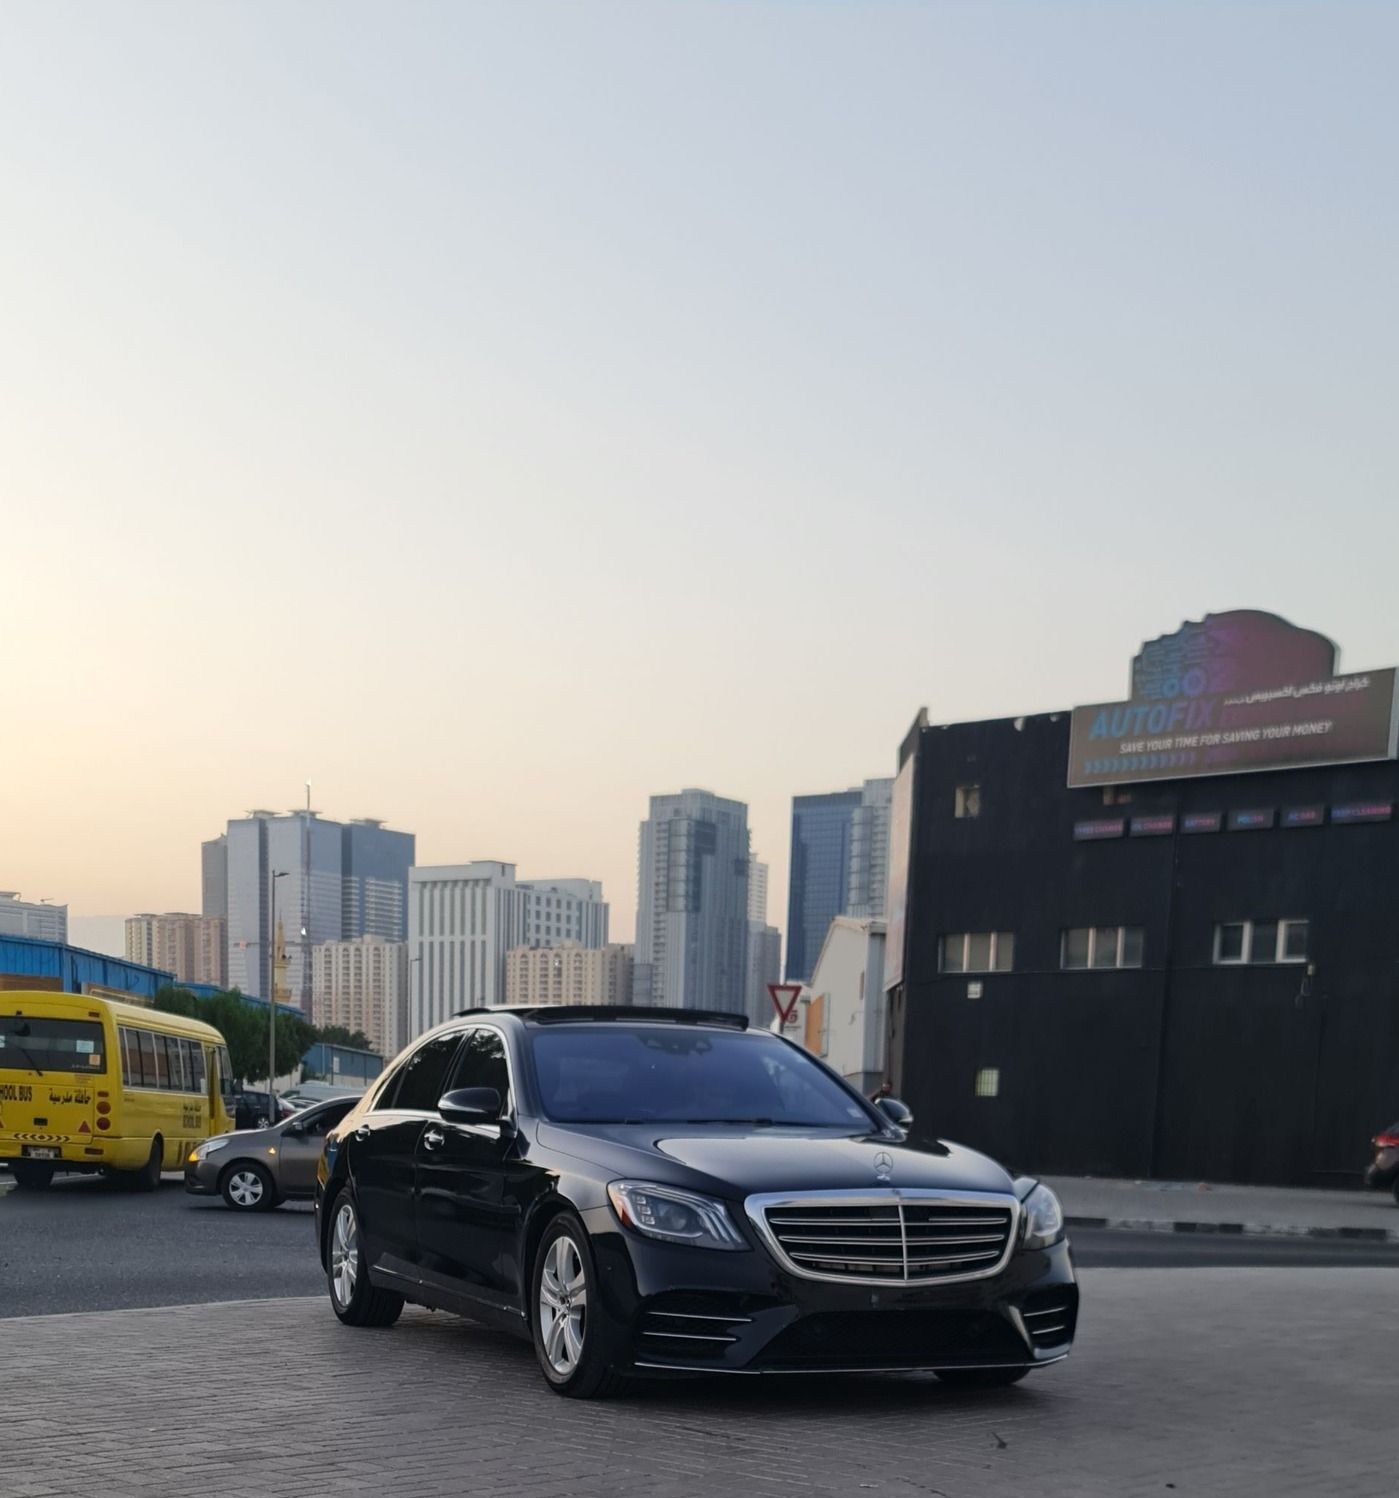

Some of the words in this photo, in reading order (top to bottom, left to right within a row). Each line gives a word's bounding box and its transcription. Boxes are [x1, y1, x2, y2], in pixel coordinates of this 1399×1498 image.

[1088, 699, 1215, 740] AUTOFIX
[1120, 741, 1145, 754] SAVE
[1146, 739, 1173, 751] YOUR
[1175, 736, 1199, 748] TIME
[1200, 733, 1220, 745] FOR
[1222, 729, 1260, 744] SAVING
[1262, 726, 1291, 739] YOUR
[1292, 720, 1333, 735] MONEY
[19, 1085, 32, 1101] BUS
